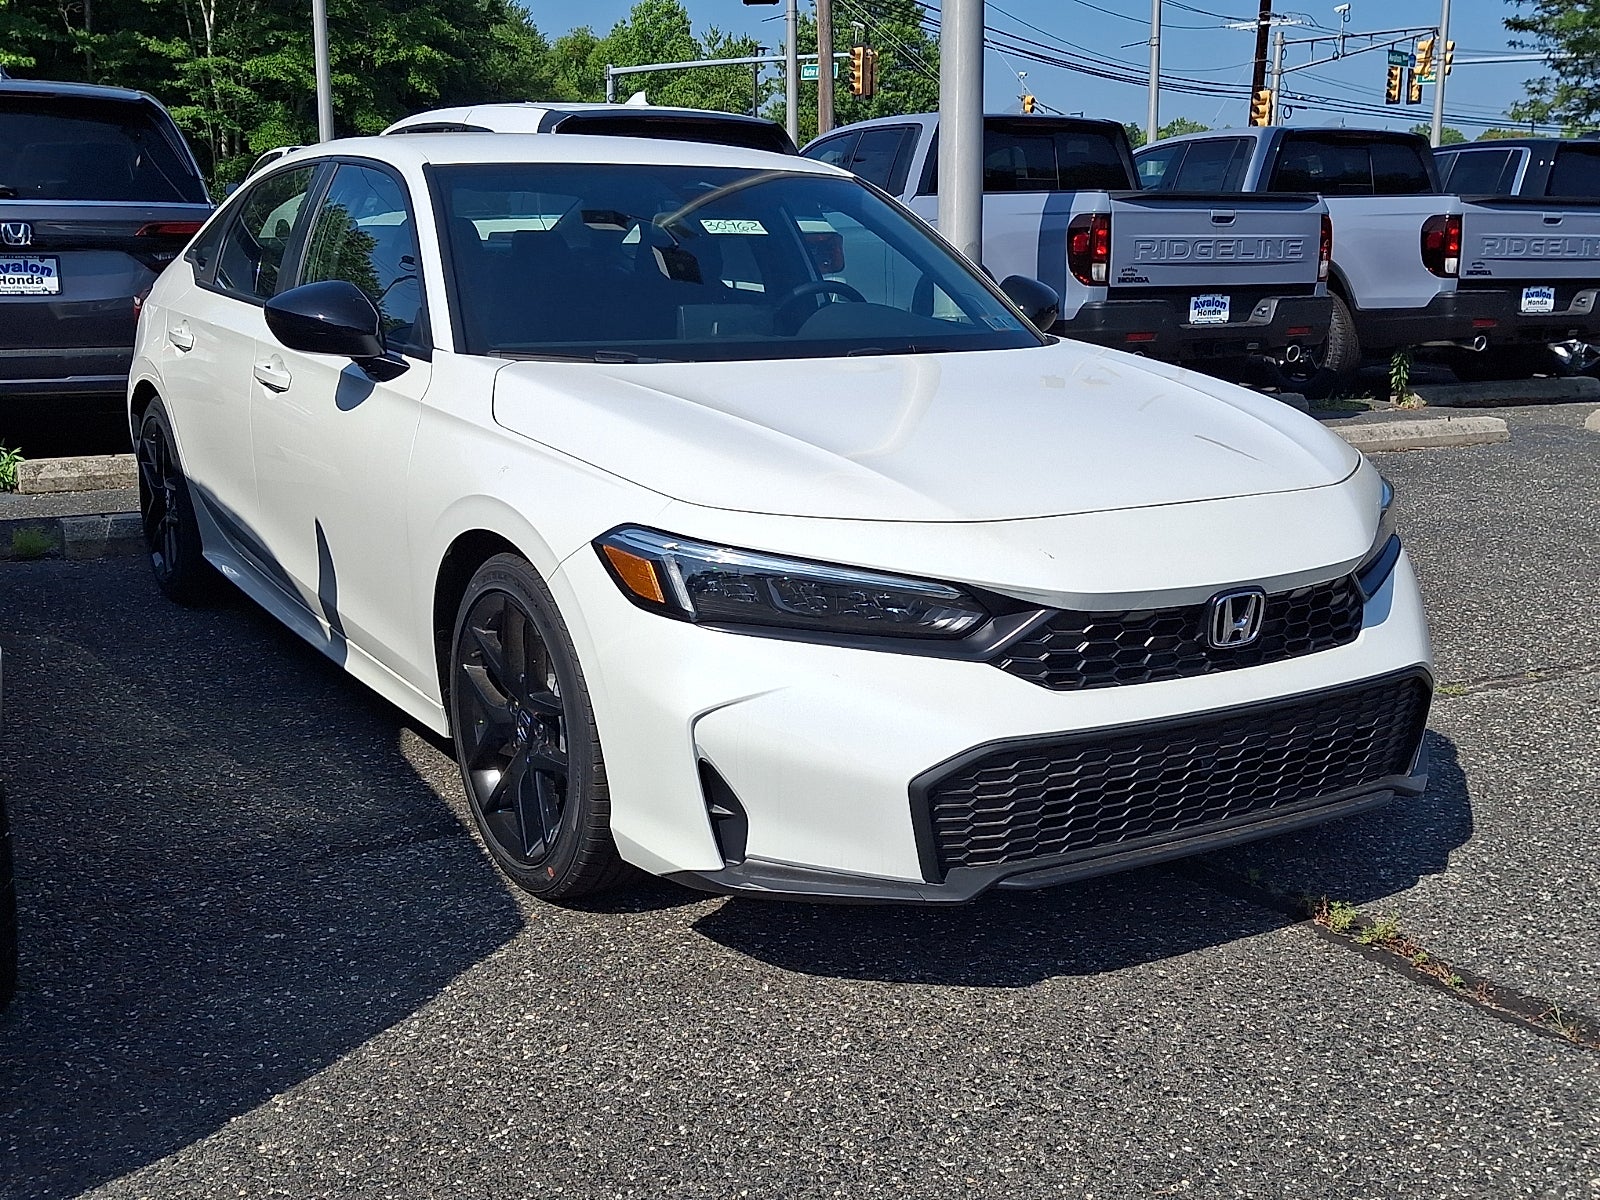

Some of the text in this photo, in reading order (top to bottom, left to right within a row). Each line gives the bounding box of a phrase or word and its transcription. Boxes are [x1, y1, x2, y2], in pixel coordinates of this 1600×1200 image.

[1134, 239, 1303, 260] RIDGELINE
[1525, 289, 1551, 300] Avalon
[1194, 297, 1227, 310] Avalon
[1197, 308, 1222, 316] Honda
